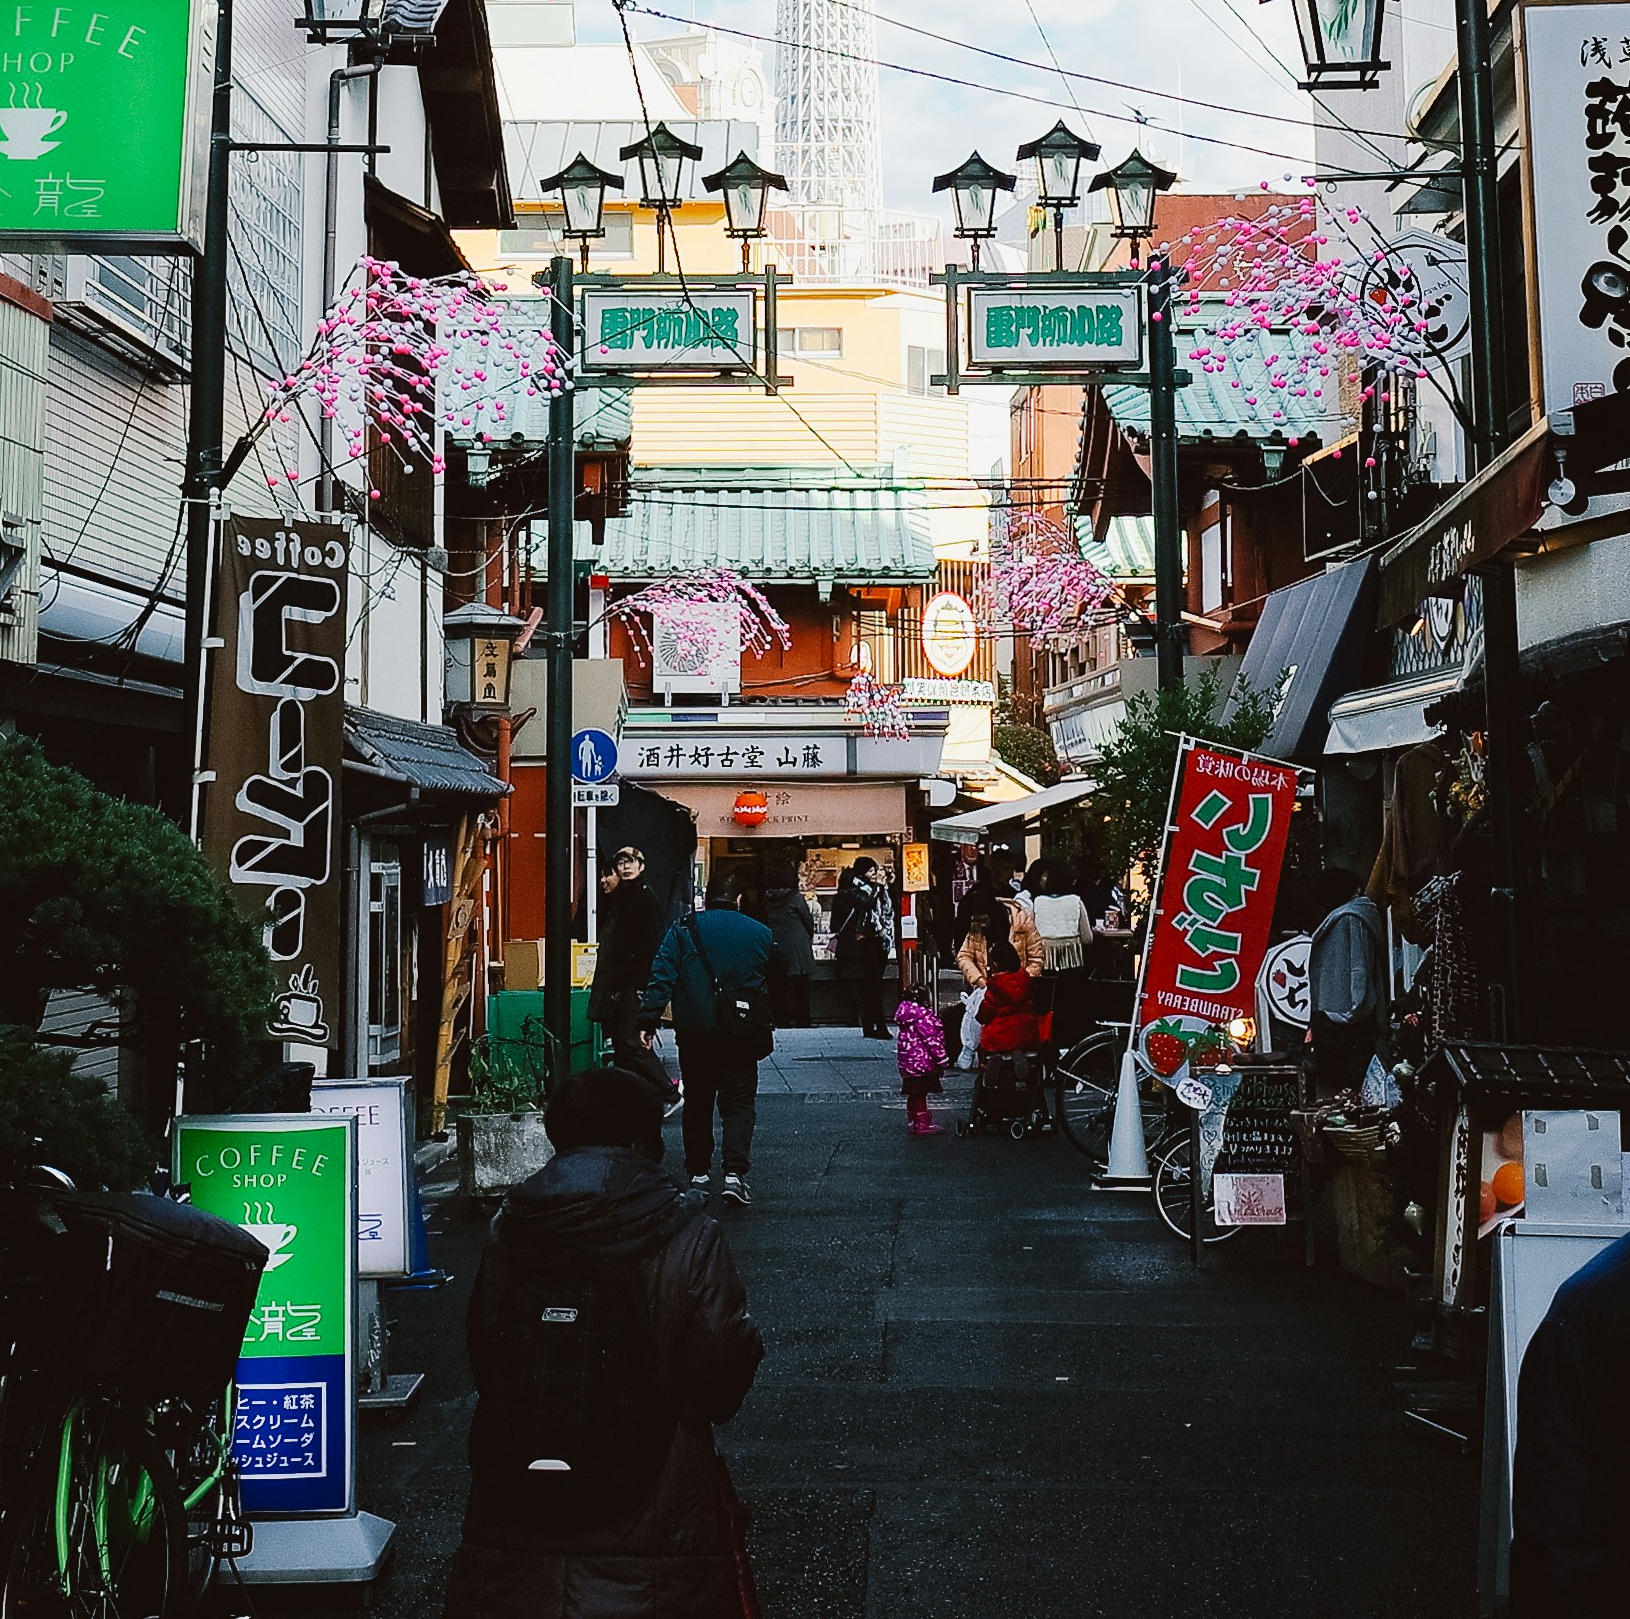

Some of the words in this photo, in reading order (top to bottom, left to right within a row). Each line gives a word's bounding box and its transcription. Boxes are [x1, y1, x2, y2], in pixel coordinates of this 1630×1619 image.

[637, 744, 766, 769] 酒井好古堂
[776, 743, 824, 769] 山藤
[195, 1144, 330, 1178] COFFEE
[232, 1173, 287, 1188] SHOP
[236, 1394, 316, 1410] ヒー・紅茶
[236, 1414, 315, 1429] スクリーム
[236, 1432, 315, 1448] ームソーダ
[232, 1452, 315, 1468] シュジュース
